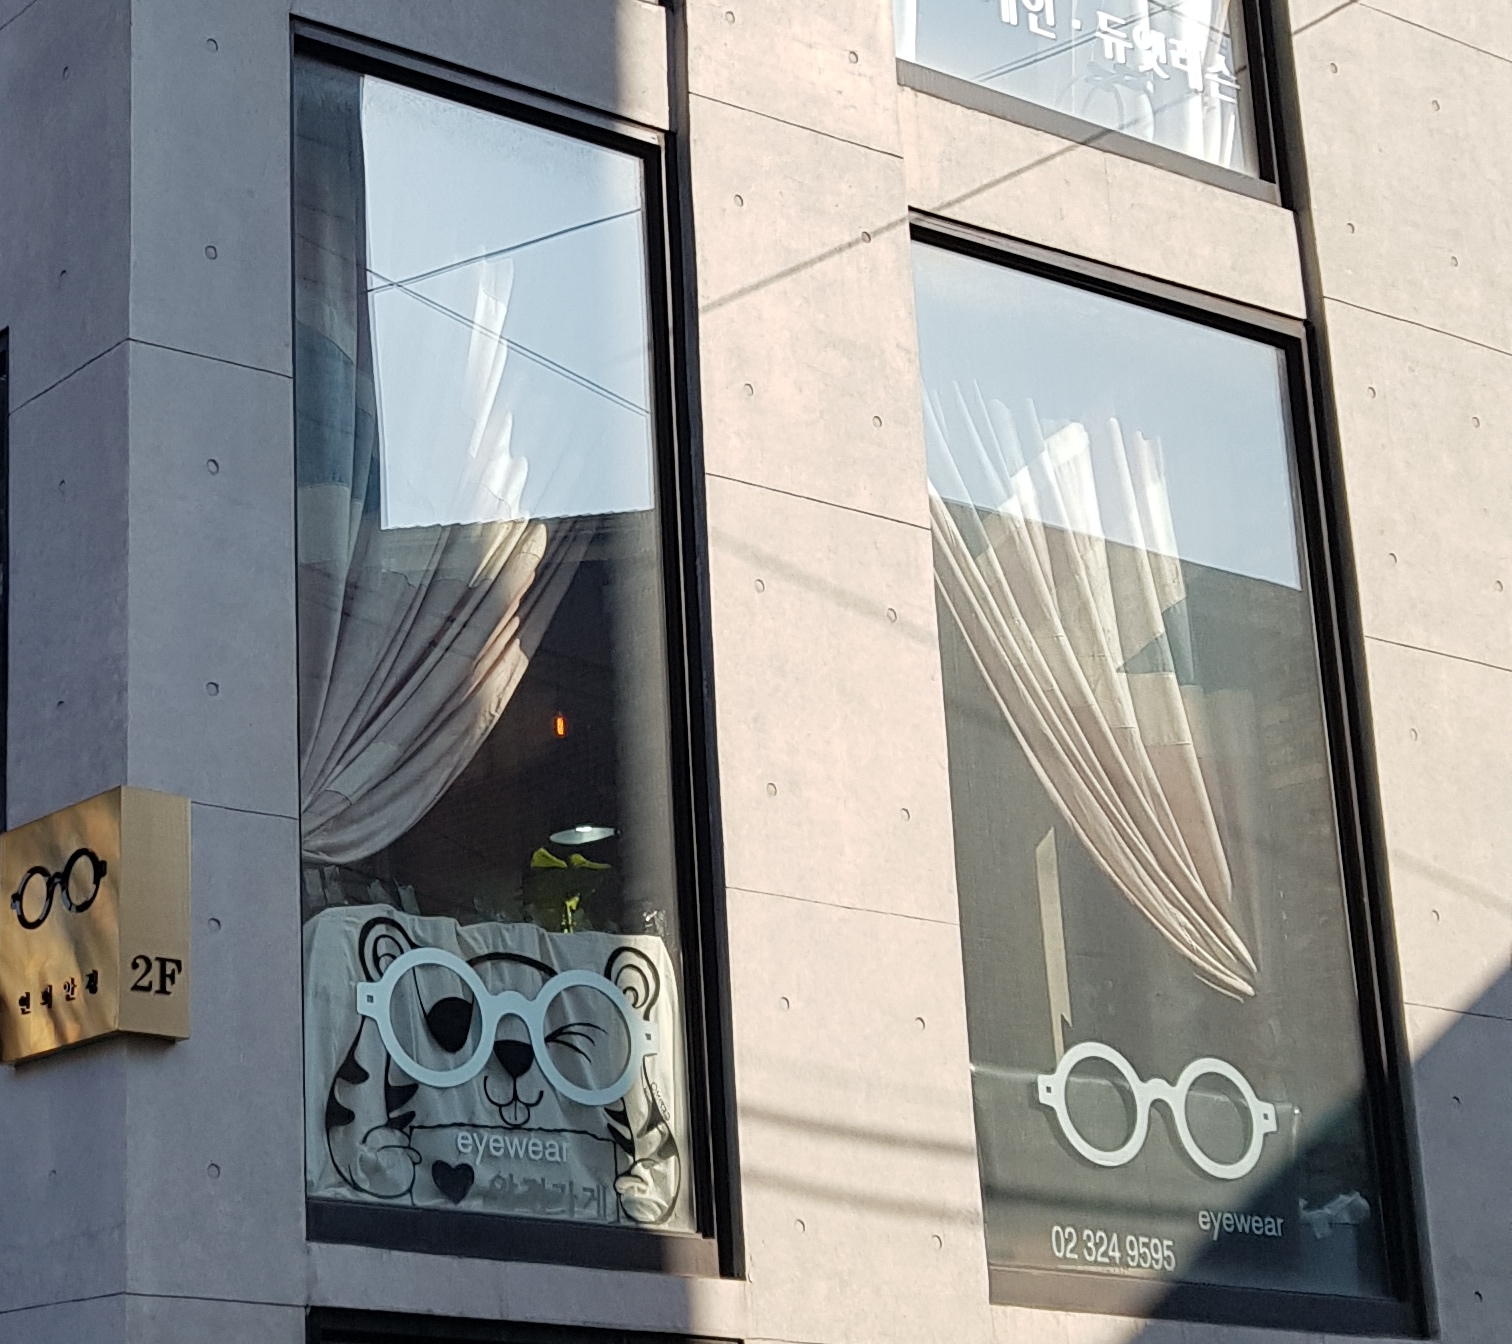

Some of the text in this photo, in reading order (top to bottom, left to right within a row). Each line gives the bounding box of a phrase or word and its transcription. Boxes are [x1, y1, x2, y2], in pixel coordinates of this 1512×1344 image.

[130, 954, 183, 996] 2F
[456, 1130, 571, 1165] eyewear
[1198, 1210, 1285, 1241] eyewear
[1051, 1225, 1177, 1272] 02 324 9595
